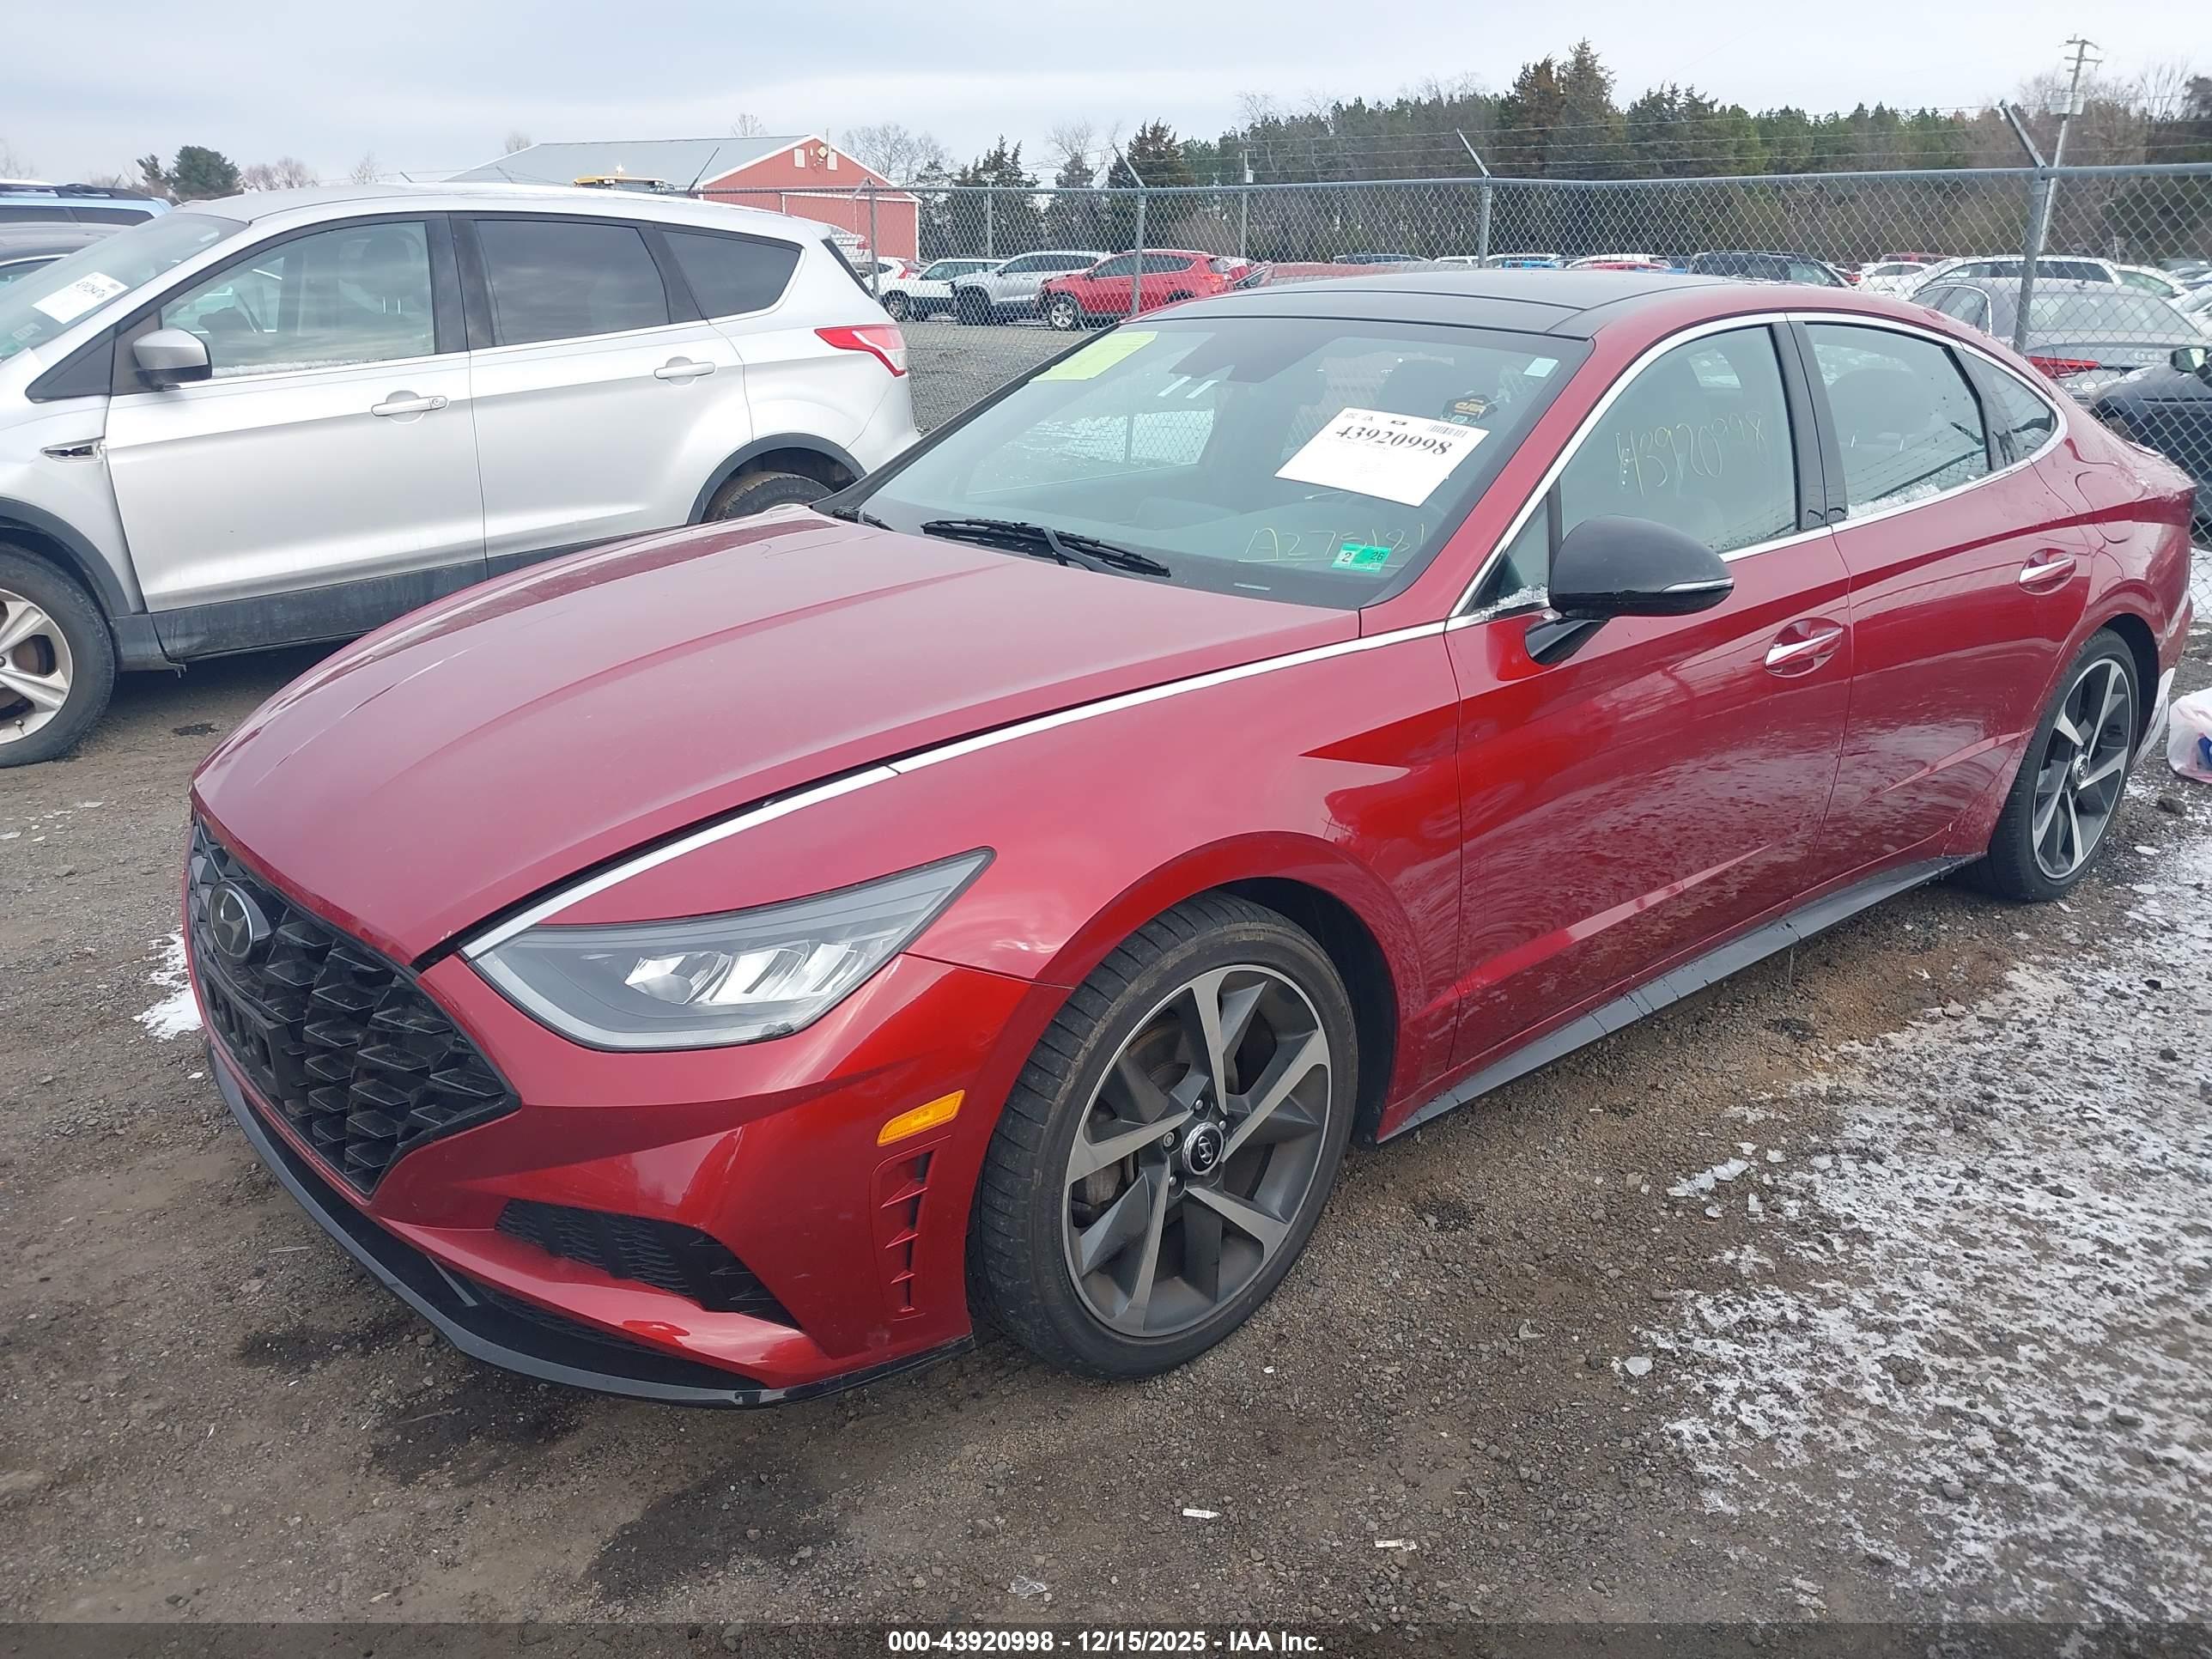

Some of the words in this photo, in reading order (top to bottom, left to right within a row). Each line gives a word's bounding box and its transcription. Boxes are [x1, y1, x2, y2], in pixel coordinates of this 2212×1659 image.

[1335, 425, 1453, 456] 43920998
[1341, 551, 1352, 562] 2
[1370, 551, 1385, 562] 26
